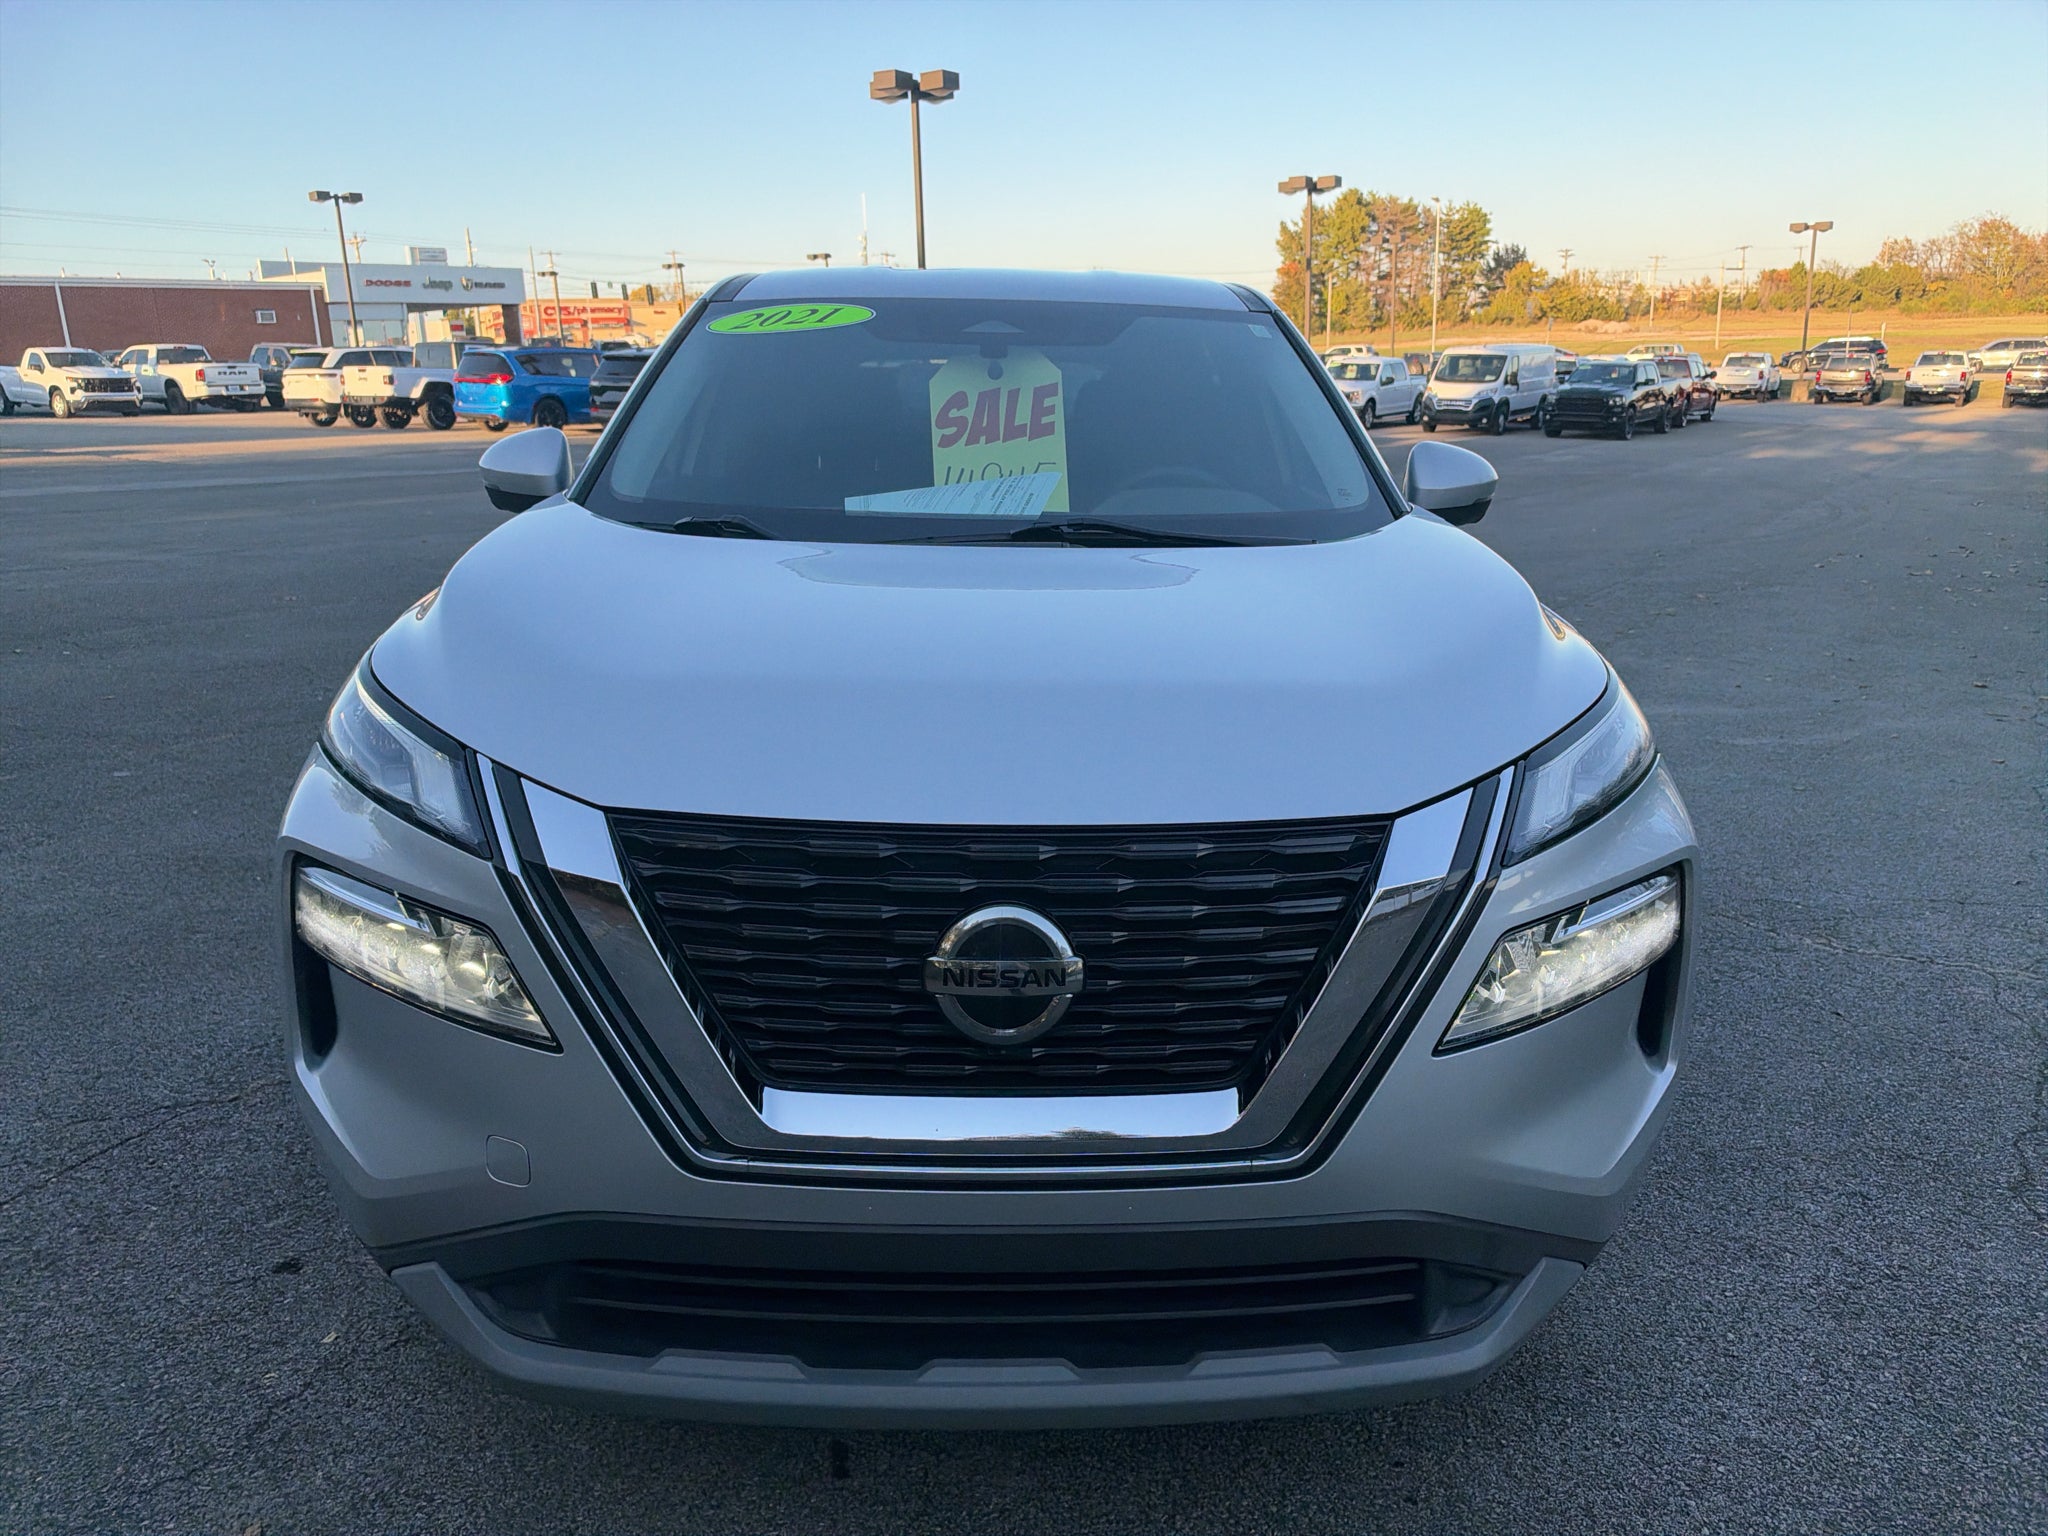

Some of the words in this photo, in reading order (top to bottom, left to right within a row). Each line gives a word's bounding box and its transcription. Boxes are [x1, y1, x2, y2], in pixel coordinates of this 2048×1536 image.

[364, 279, 412, 288] DODGE
[423, 275, 453, 291] Jeep
[727, 307, 845, 330] 2021
[934, 382, 1060, 449] SALE
[942, 967, 1067, 988] NISSAN
